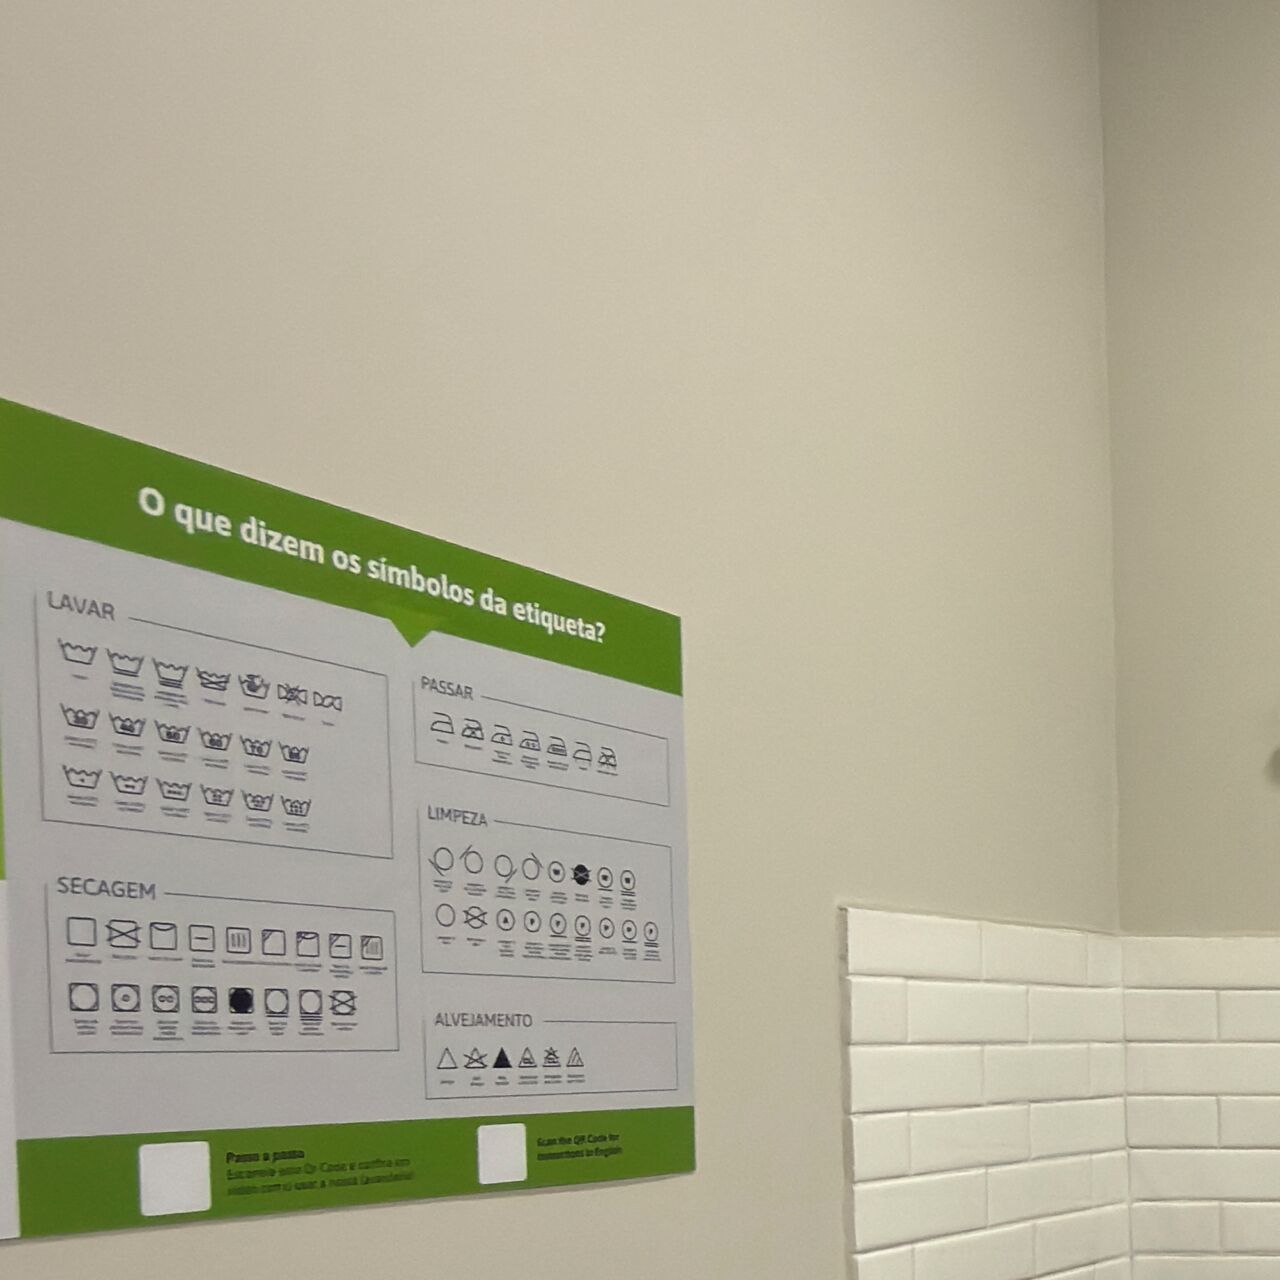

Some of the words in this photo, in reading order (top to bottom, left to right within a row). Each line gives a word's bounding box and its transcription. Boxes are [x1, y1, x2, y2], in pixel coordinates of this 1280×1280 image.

[139, 487, 165, 516] O
[174, 503, 232, 537] que
[240, 516, 324, 564] dizem
[332, 550, 361, 574] os
[367, 557, 474, 606] símbolos
[480, 587, 507, 615] da
[513, 602, 606, 643] etiqueta?
[47, 591, 115, 621] LAVAR
[421, 676, 473, 700] PASSAR
[428, 805, 488, 826] LIMPEZA
[57, 876, 155, 900] SECAGEM
[434, 1012, 532, 1027] ALVEJAMENTO
